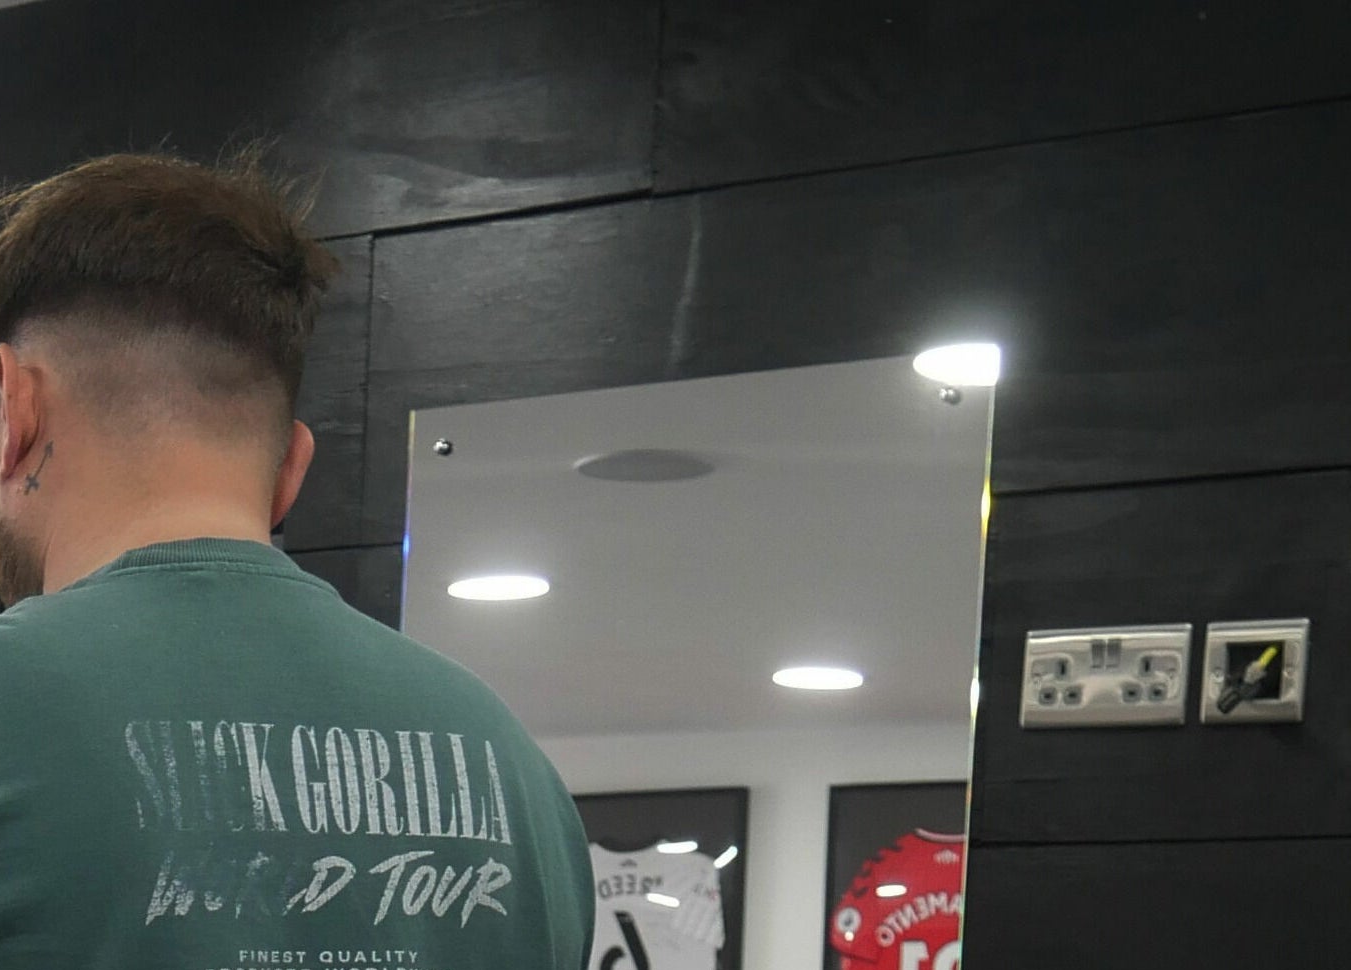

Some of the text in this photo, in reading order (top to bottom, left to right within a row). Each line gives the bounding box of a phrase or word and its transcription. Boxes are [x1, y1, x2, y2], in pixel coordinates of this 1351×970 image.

[291, 725, 513, 846] GORILLA
[369, 850, 513, 929] TOUR
[238, 950, 419, 964] FINEST QUALITY
